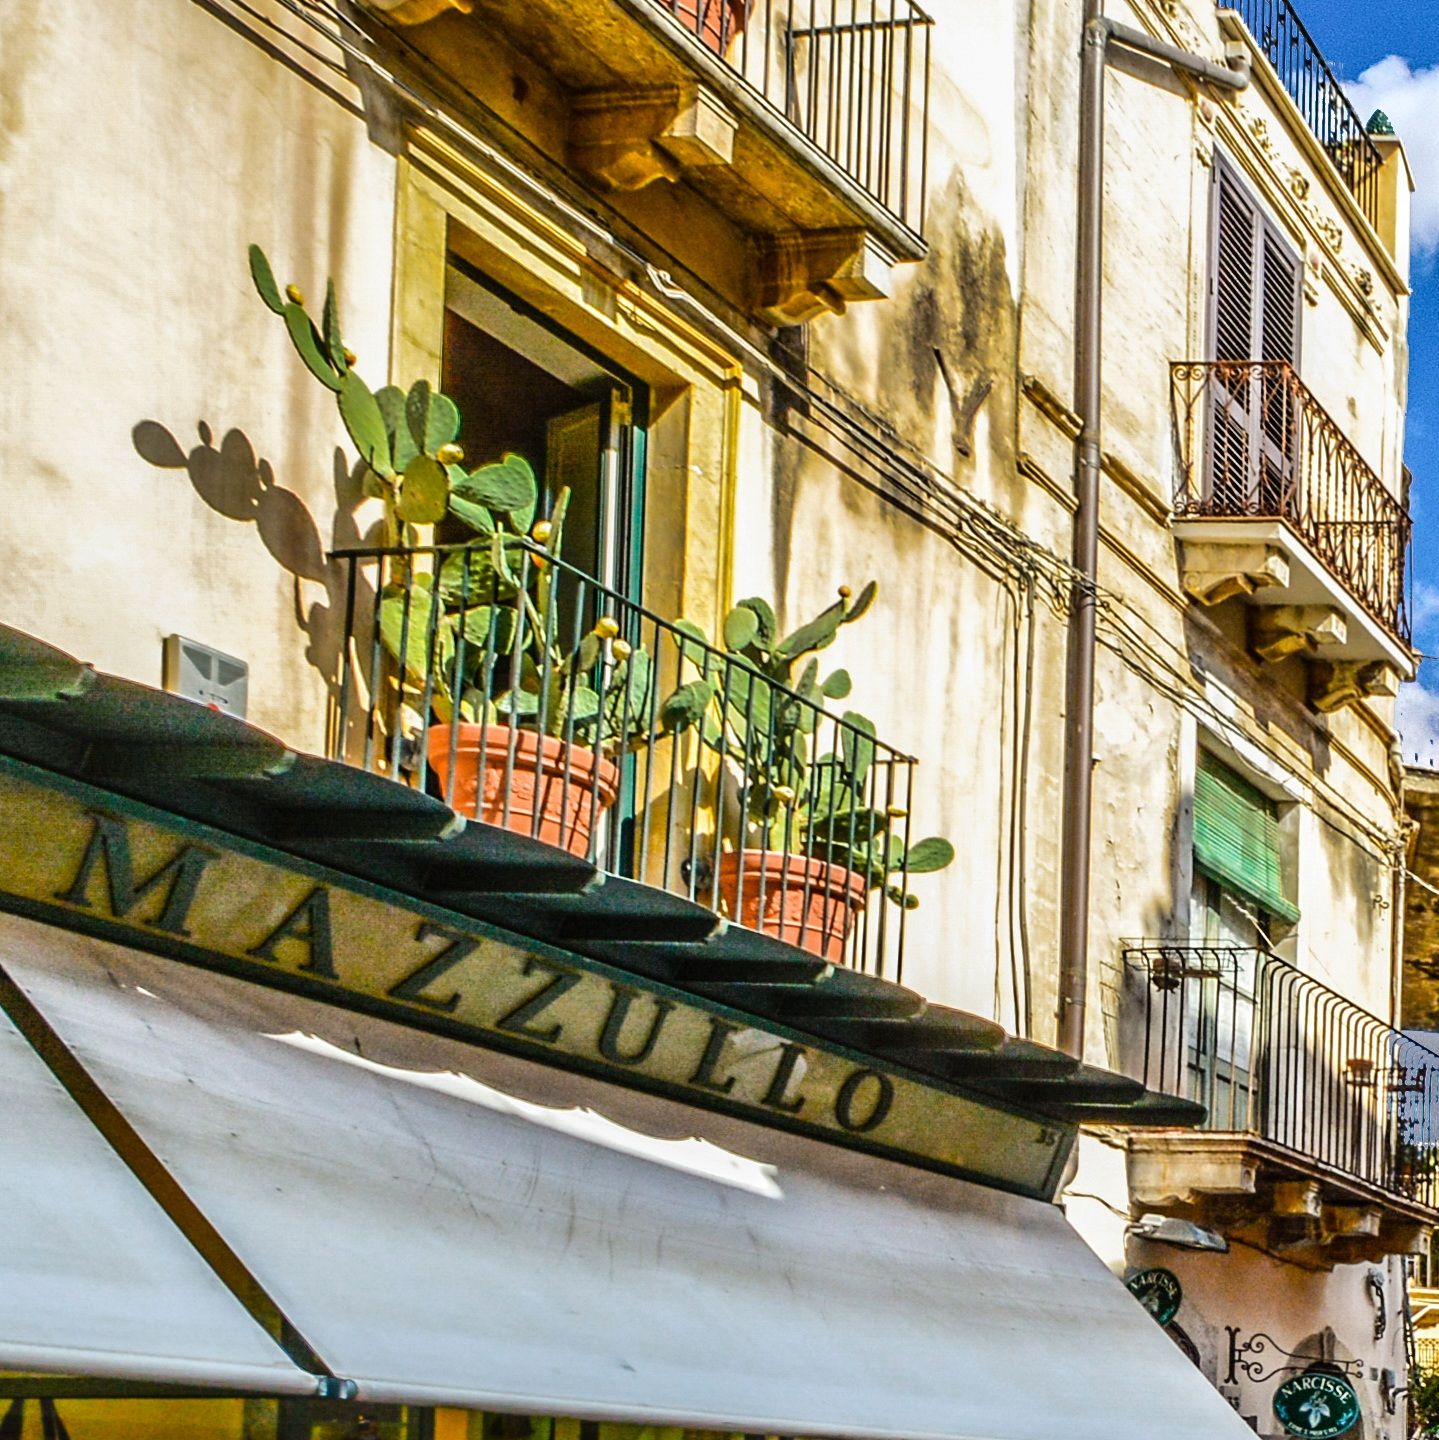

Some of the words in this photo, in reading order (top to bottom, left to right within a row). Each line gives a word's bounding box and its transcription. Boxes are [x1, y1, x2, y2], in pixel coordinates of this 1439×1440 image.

[56, 813, 896, 1132] MAZZULLO
[1130, 1271, 1178, 1298] NARCISSE
[1281, 1376, 1352, 1404] NARCISSE
